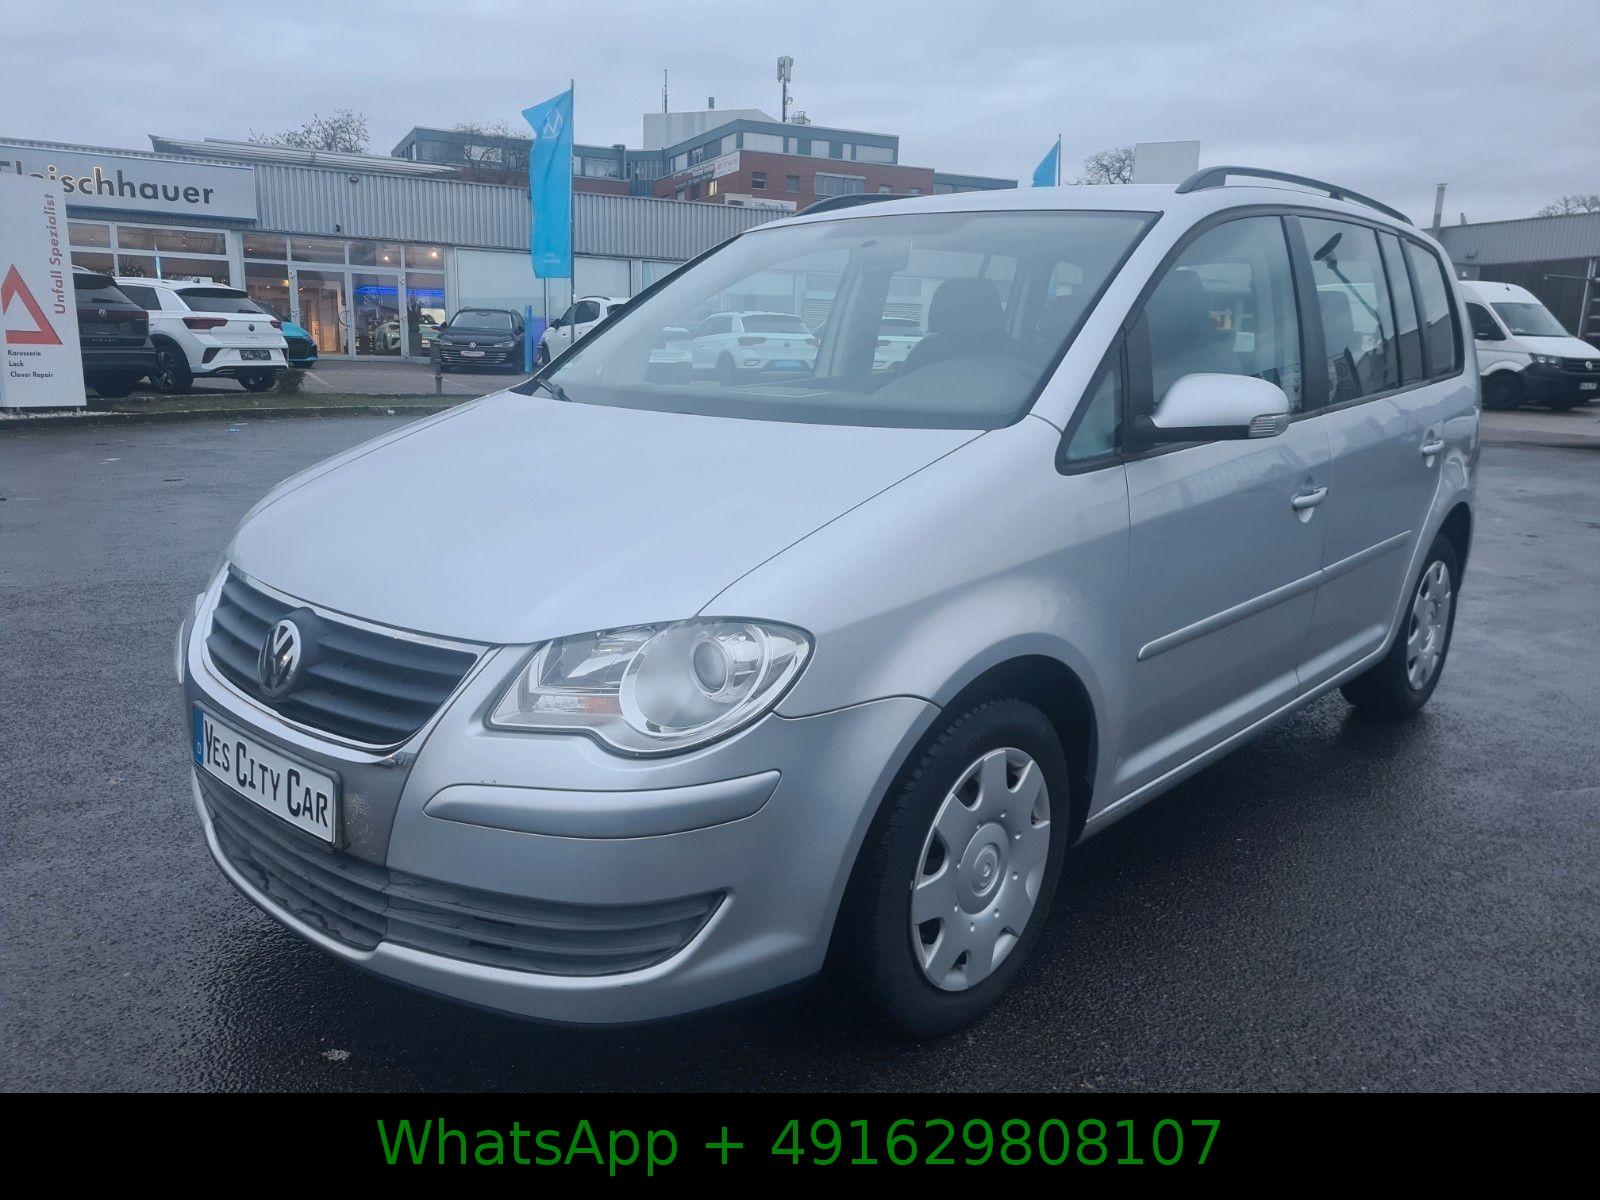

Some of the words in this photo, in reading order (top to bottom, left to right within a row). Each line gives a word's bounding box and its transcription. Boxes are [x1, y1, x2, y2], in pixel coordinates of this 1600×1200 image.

[43, 193, 63, 266] Spezialist
[50, 270, 66, 315] Unfall
[7, 349, 42, 357] Karosserie
[32, 371, 54, 379] Repair
